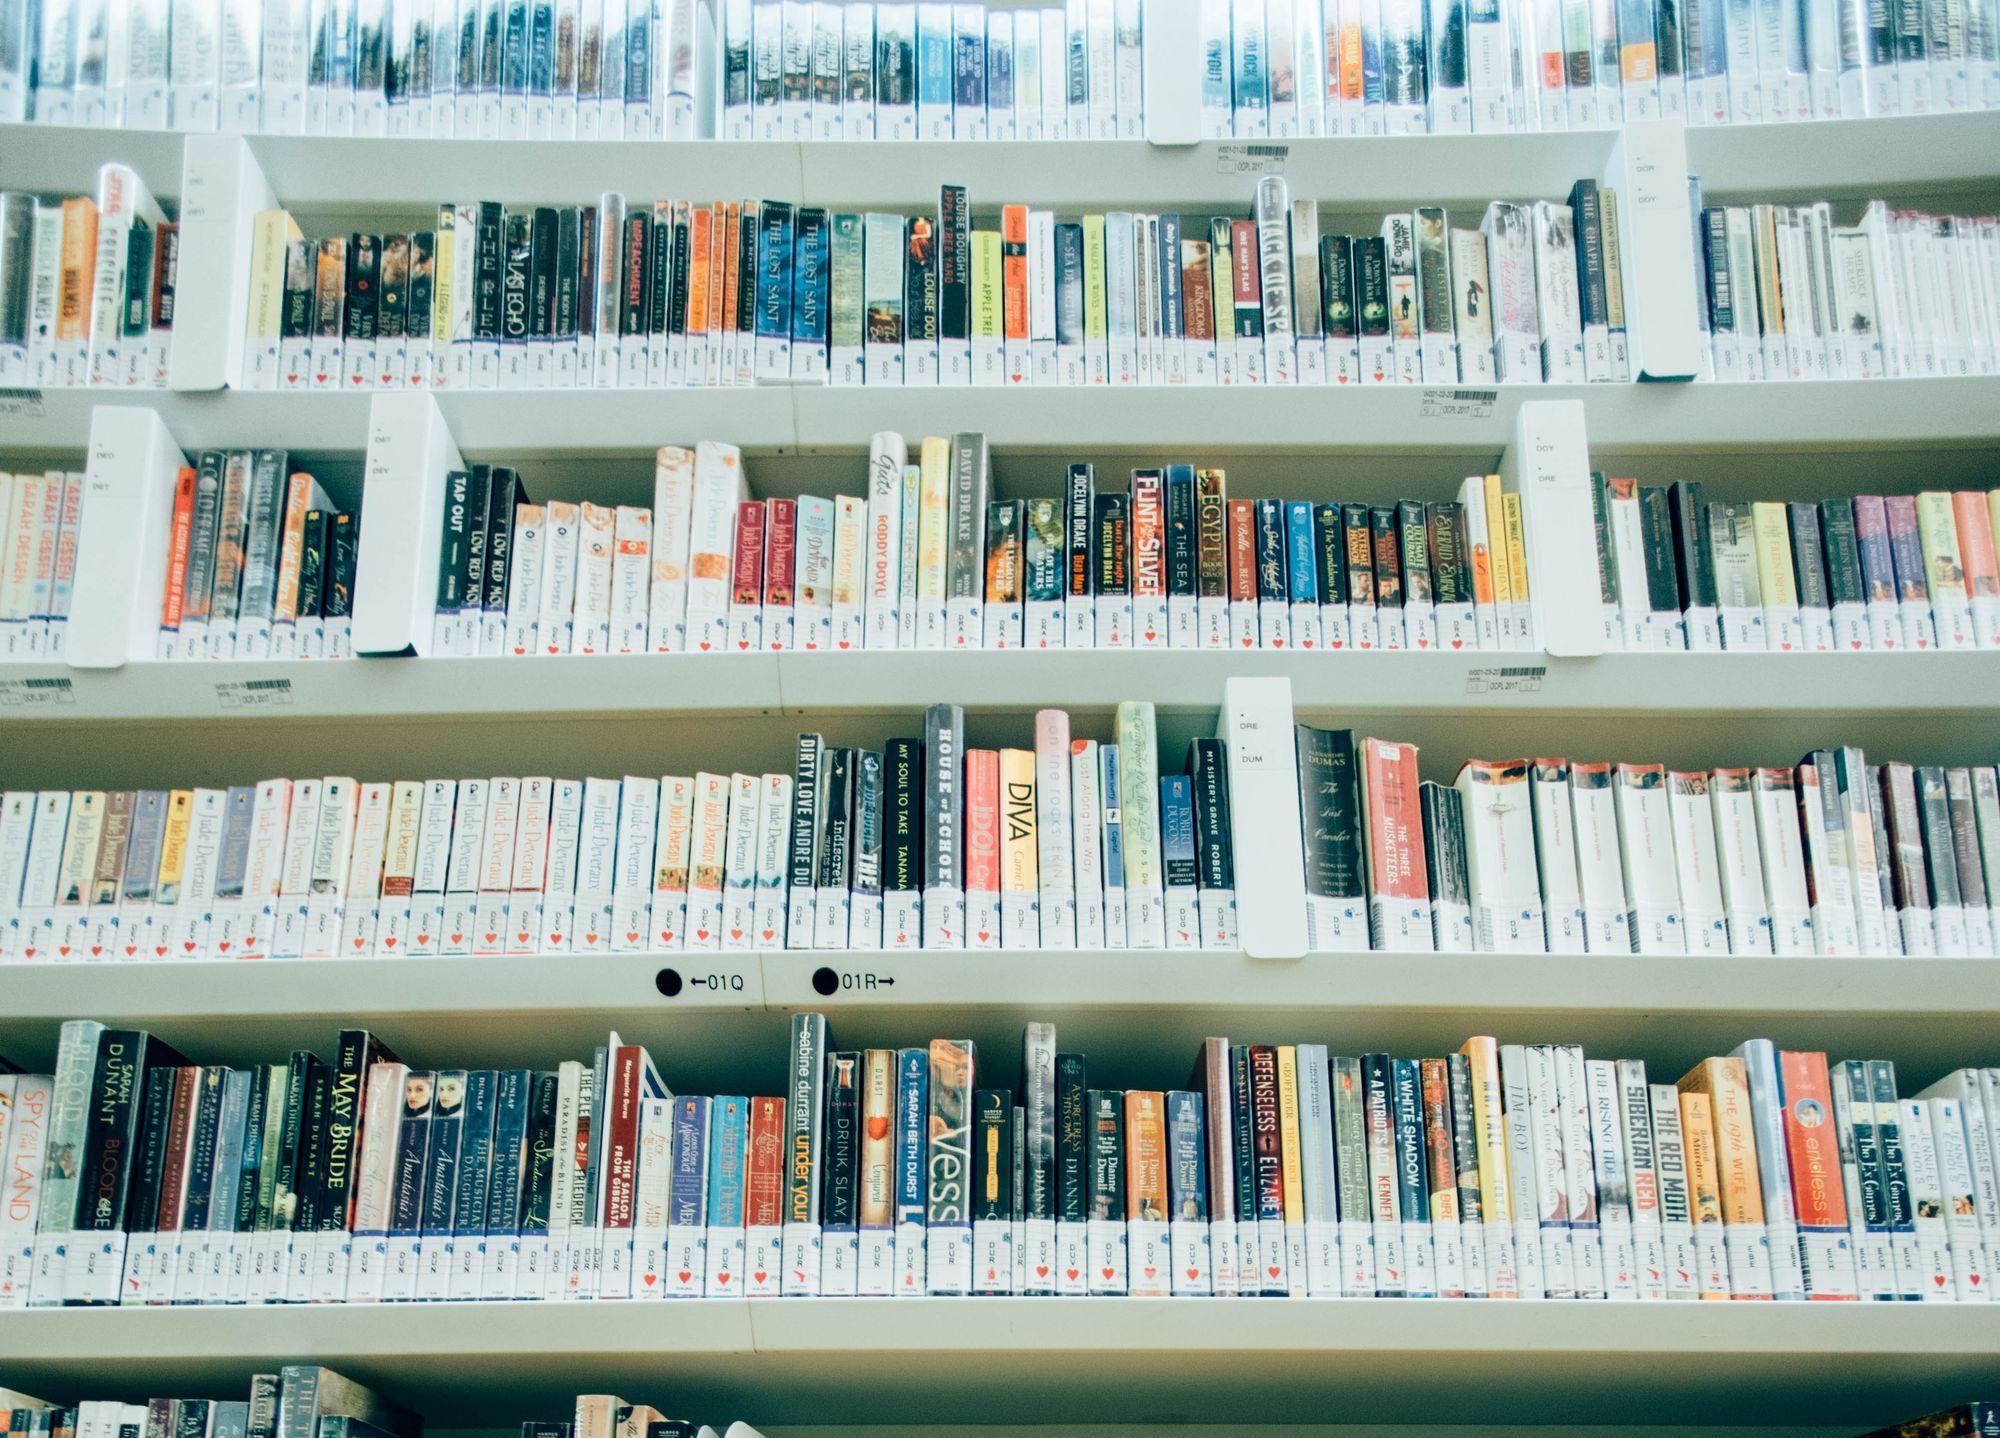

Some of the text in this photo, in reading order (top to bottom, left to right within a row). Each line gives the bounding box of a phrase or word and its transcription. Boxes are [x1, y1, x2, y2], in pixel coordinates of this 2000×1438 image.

[630, 219, 643, 306] IMPEACHMENT
[955, 191, 967, 284] LOUISE DOUGHTY
[1165, 224, 1176, 260] Only the
[1241, 231, 1251, 292] ONE MAN'S FLAG
[1391, 219, 1402, 258] DOWARD
[1400, 225, 1410, 252] JAMIE
[1583, 195, 1599, 275] THE CHAPEL
[560, 278, 571, 316] THE BODY
[767, 219, 782, 323] THE LOST SAINT
[804, 224, 818, 328] THE LOST SAINT
[923, 272, 936, 312] LOUISE
[1265, 272, 1286, 298] OF
[1330, 252, 1342, 301] RABBIT HOLE
[1364, 254, 1376, 302] RABBIT HOLE
[1853, 250, 1868, 298] SHERLOCK
[506, 293, 525, 335] ECHO
[535, 318, 546, 332] THE
[981, 284, 992, 337] APPLE TREE
[1193, 285, 1206, 335] KINGDOMS
[872, 455, 898, 557] Guts RODDY
[958, 448, 973, 541] DAVID DRAKE
[1073, 473, 1087, 549] JOCELYNN DRAKE
[1173, 486, 1181, 518] DRABBLE
[196, 513, 213, 554] FRAME
[447, 478, 467, 600] TAP OUT DEVINE
[469, 531, 483, 579] LOW RED
[1102, 521, 1113, 585] JOCELYNN DRAKE
[1113, 520, 1125, 585] burn the night
[1136, 476, 1163, 598] FLINT SILVER
[1201, 494, 1222, 556] EGYPT
[1349, 530, 1360, 565] HONOR
[1358, 529, 1370, 567] EXTREME
[1378, 539, 1388, 566] TRUST
[1405, 524, 1416, 568] COURAGE
[1413, 526, 1426, 569] ULTIMATE
[490, 533, 507, 582] LOW RED
[1035, 551, 1046, 589] WATERS
[1044, 559, 1055, 589] OF THE
[1176, 534, 1188, 588] THE SEA
[1237, 523, 1250, 596] Bella BEAST
[1328, 529, 1340, 587] The Scandalous
[898, 744, 908, 834] MY SOUL TO TAKE
[939, 729, 951, 793] HOUSE
[1308, 757, 1346, 767] DUMAS
[735, 804, 754, 872] Jude Deveraux
[766, 804, 786, 826] Jude
[794, 740, 816, 885] DIRTY LOVE ANDRE DU
[858, 786, 877, 886] JOE THE
[1006, 783, 1033, 880] DIVA Carrie
[1048, 754, 1066, 878] the rocks ERIN
[1076, 756, 1094, 873] Lost Along the Way
[1110, 831, 1119, 854] Capital
[1180, 807, 1191, 846] ROBERT
[1206, 750, 1221, 886] MY SISTER'S GRAVE ROBERT
[588, 805, 614, 889] Jude Deveraux
[1382, 816, 1399, 884] MUSKETEERS
[1397, 825, 1411, 876] THE THREE
[708, 975, 744, 991] 01Q
[842, 973, 877, 990] 01R
[100, 1043, 124, 1125] DUNANT
[118, 1064, 134, 1104] SARAH
[580, 1073, 593, 1093] THE
[622, 1060, 633, 1119] Marguerite Duras
[1254, 1052, 1275, 1132] DEFENSELESS
[328, 1045, 357, 1190] THE MAY BRIDE
[790, 1031, 814, 1221] sabine durrant under your
[906, 1089, 919, 1200] SARAH BETH DURST
[1400, 1079, 1419, 1187] WHITE SHADOW
[1725, 1088, 1746, 1195] THE WIFE
[555, 1097, 571, 1210] PARADISE BLIND
[1097, 1158, 1107, 1190] Duvall
[1107, 1157, 1118, 1192] Dianne
[1179, 1160, 1189, 1189] Duvall
[1188, 1160, 1198, 1191] Dianne
[1350, 1112, 1367, 1219] Every Contact Leaves
[1626, 1086, 1657, 1210] SIBERIAN RED
[1655, 1108, 1688, 1223] THE RED MOTH
[1805, 1137, 1827, 1212] endless
[458, 1156, 474, 1226] DAUGHTER
[490, 1154, 506, 1224] DAUGHTER
[610, 1145, 623, 1227] FROM GIBRALTA
[619, 1160, 632, 1220] THE SAILOR
